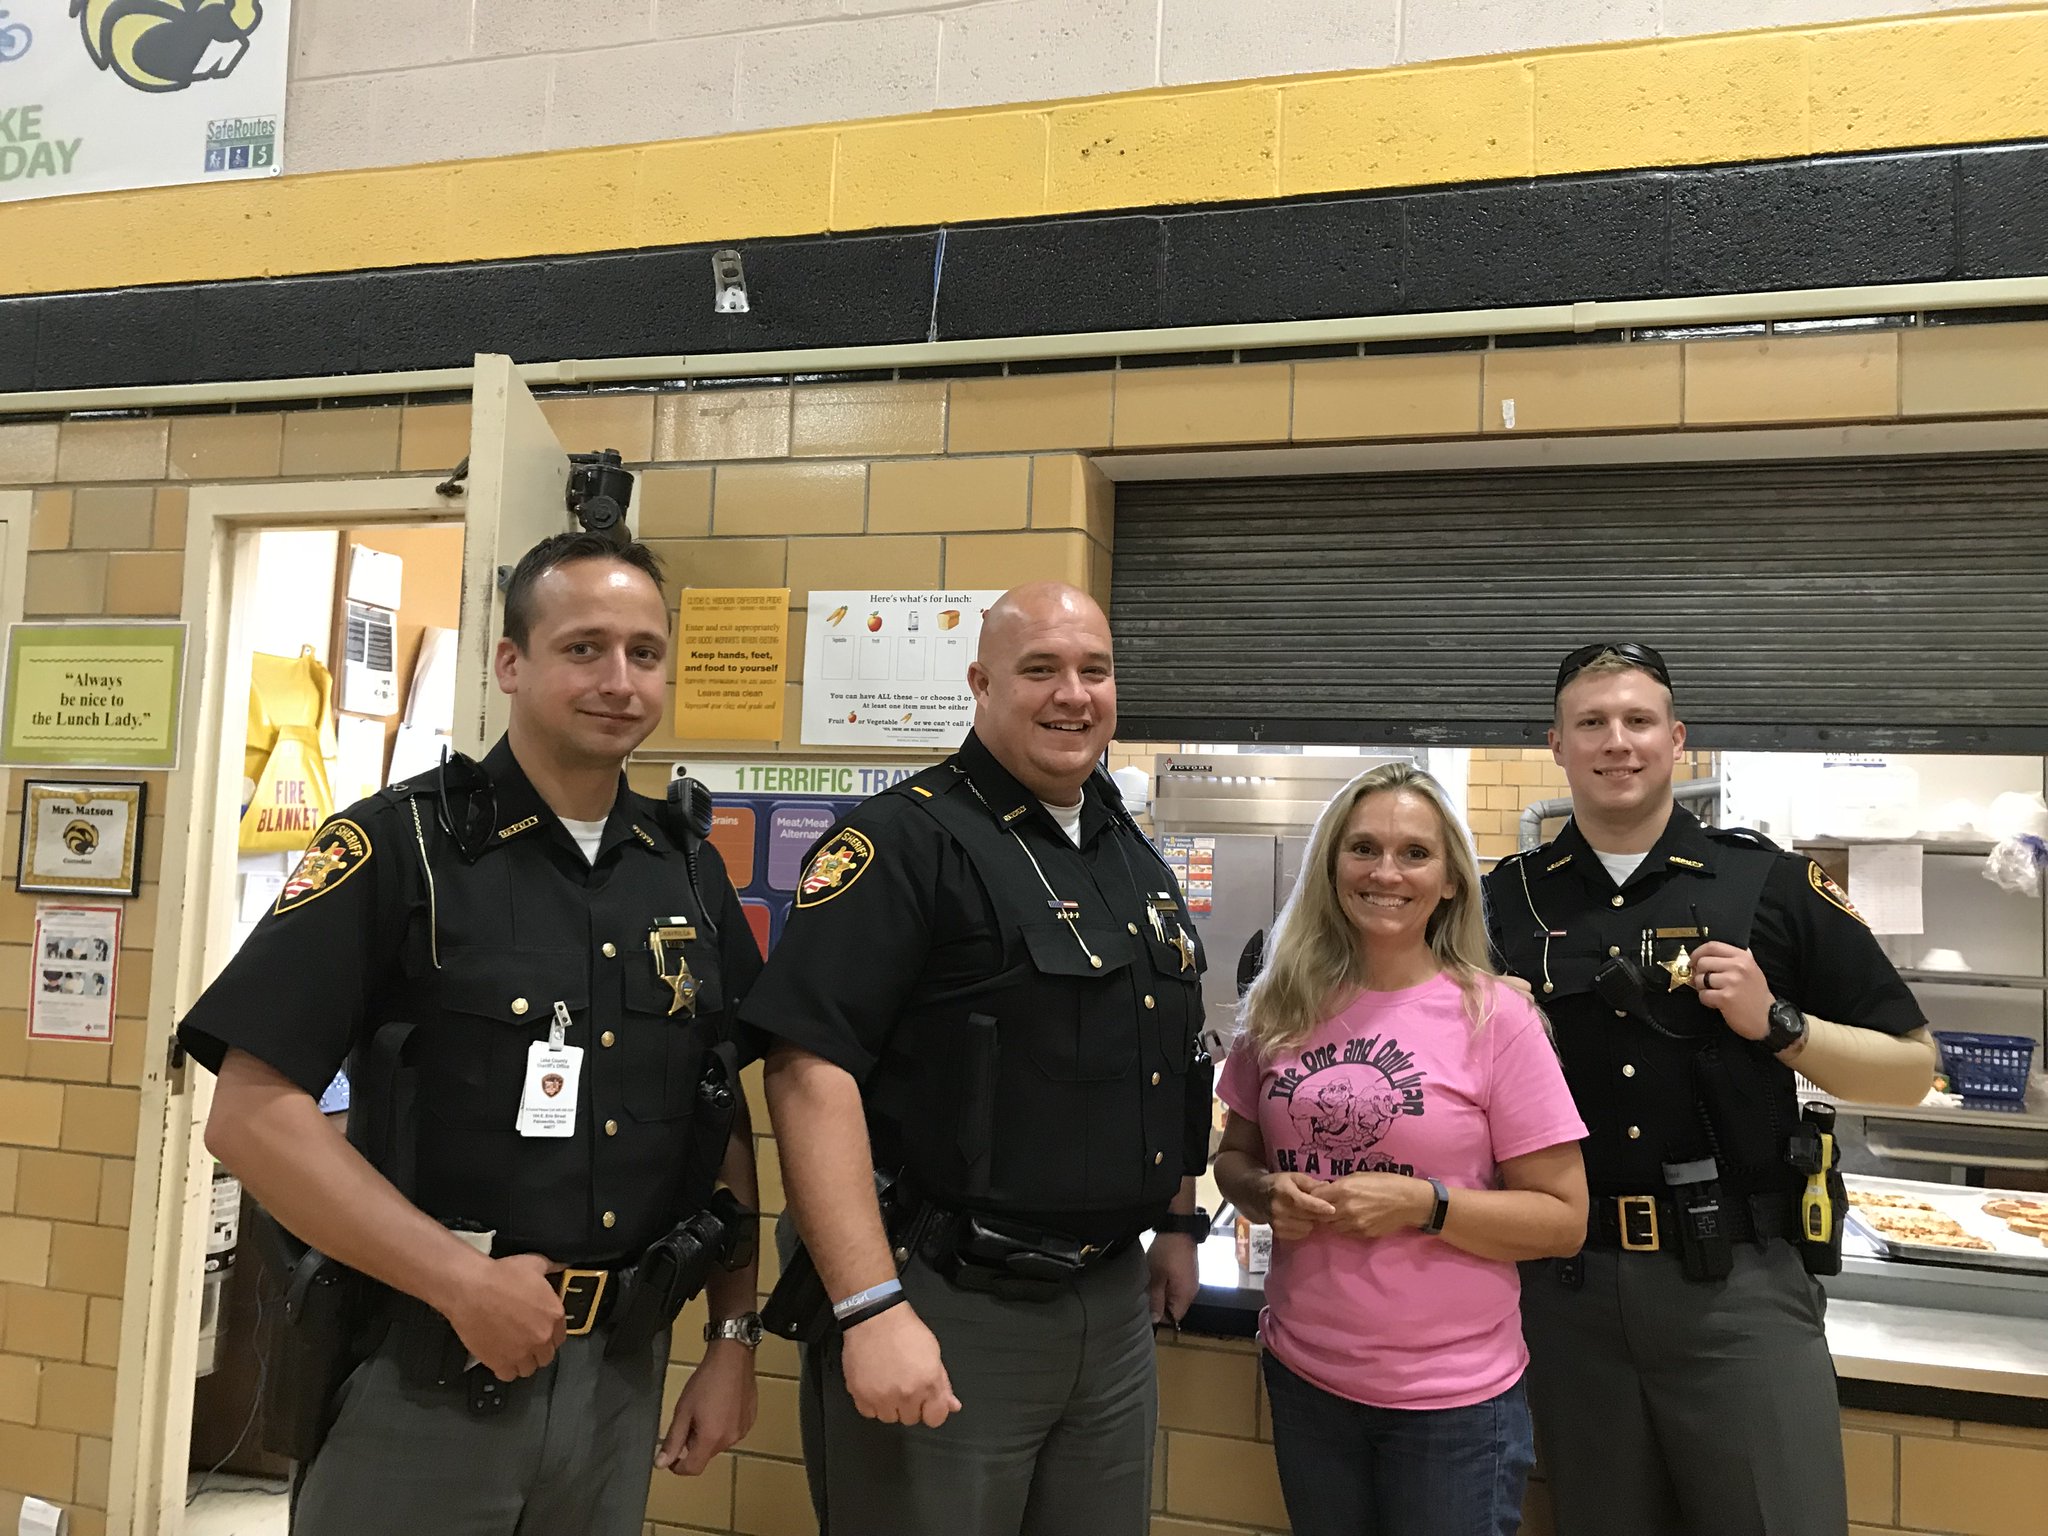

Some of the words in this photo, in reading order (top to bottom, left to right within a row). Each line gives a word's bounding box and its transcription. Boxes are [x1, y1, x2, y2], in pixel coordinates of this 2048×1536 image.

[207, 118, 276, 140] SafeRoutes
[870, 594, 897, 603] Here's
[900, 594, 928, 603] what's
[929, 594, 943, 603] for
[944, 594, 972, 603] lunch:
[705, 623, 718, 631] and
[691, 651, 715, 660] Keep
[718, 651, 748, 660] hands,
[751, 651, 773, 660] feet,
[684, 664, 702, 672] and
[704, 664, 725, 672] food
[740, 664, 778, 673] yourself
[60, 692, 76, 707] be
[80, 692, 107, 707] nice
[111, 694, 124, 707] to
[697, 689, 721, 697] Leave
[742, 689, 763, 697] clean
[32, 711, 52, 726] the
[56, 712, 100, 726] Lunch
[735, 767, 745, 791] 1
[750, 767, 853, 793] TERRIFIC
[276, 780, 306, 805] FIRE
[52, 805, 74, 815] Mrs.
[76, 806, 114, 816] Matson
[257, 807, 319, 833] BLANKET
[777, 817, 829, 828] Meat/Meat
[335, 825, 363, 857] SHERIFF
[841, 832, 868, 858] SHERIFF
[1268, 1068, 1303, 1100] The
[1301, 1043, 1337, 1072] One
[1343, 1033, 1382, 1062] and
[1373, 1038, 1415, 1077] Only
[1277, 1149, 1299, 1172] BE
[1305, 1151, 1321, 1175] A
